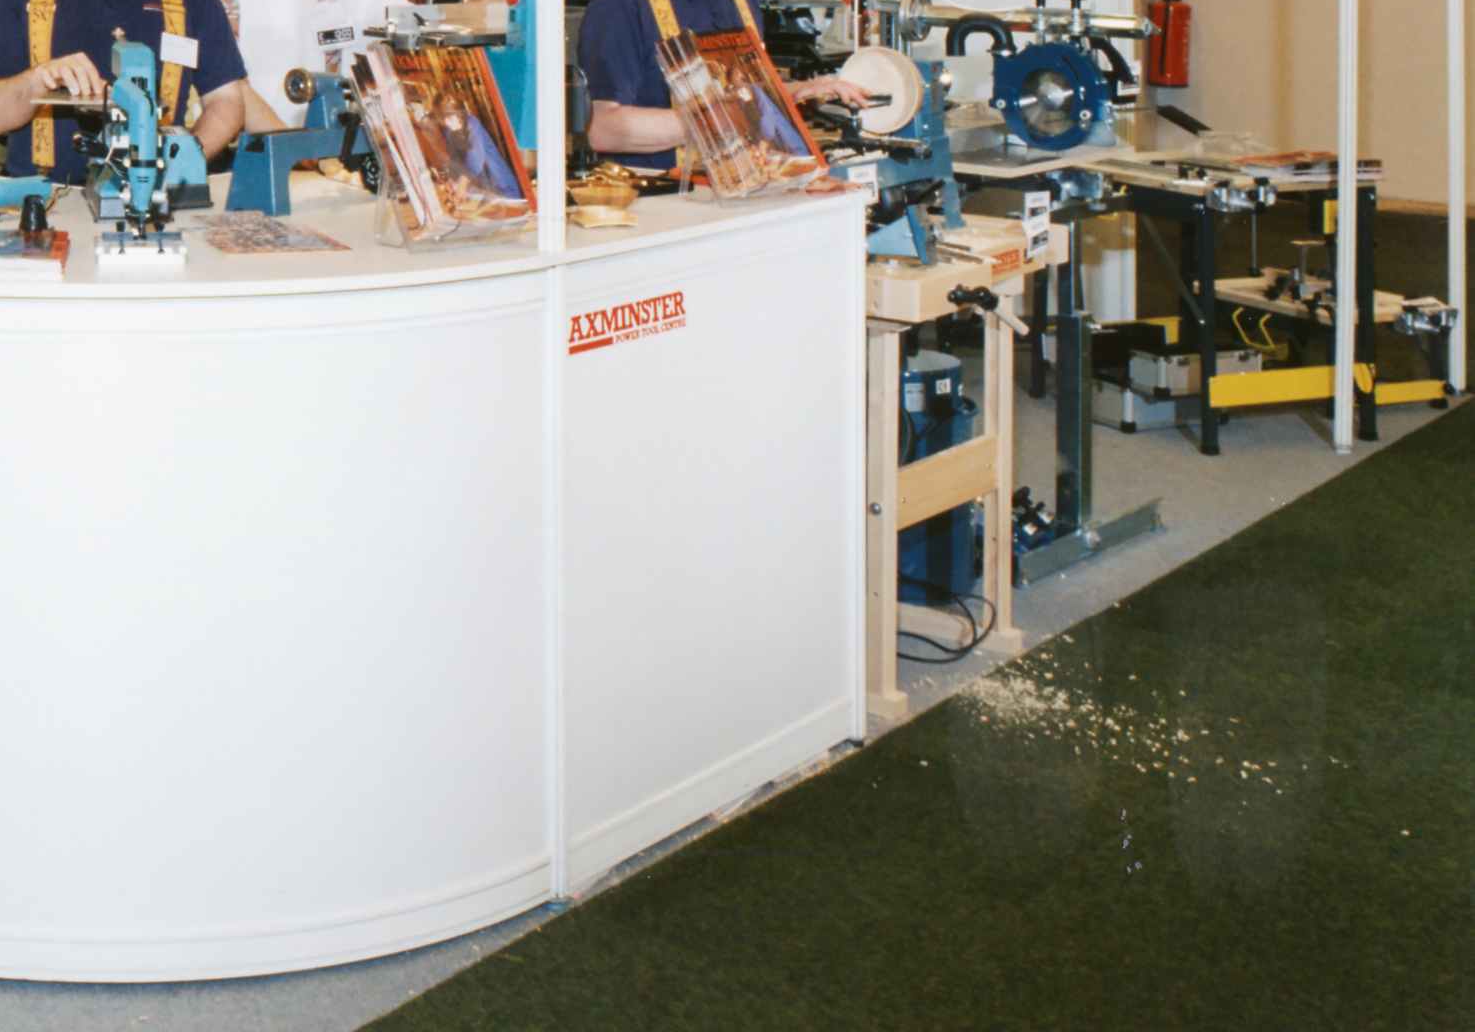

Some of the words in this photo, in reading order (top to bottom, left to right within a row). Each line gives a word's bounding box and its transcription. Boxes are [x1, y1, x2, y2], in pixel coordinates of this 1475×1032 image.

[568, 291, 685, 343] AXMINSTER
[615, 329, 640, 344] POWER
[641, 325, 659, 337] TOOL
[660, 318, 686, 332] CENTRE
